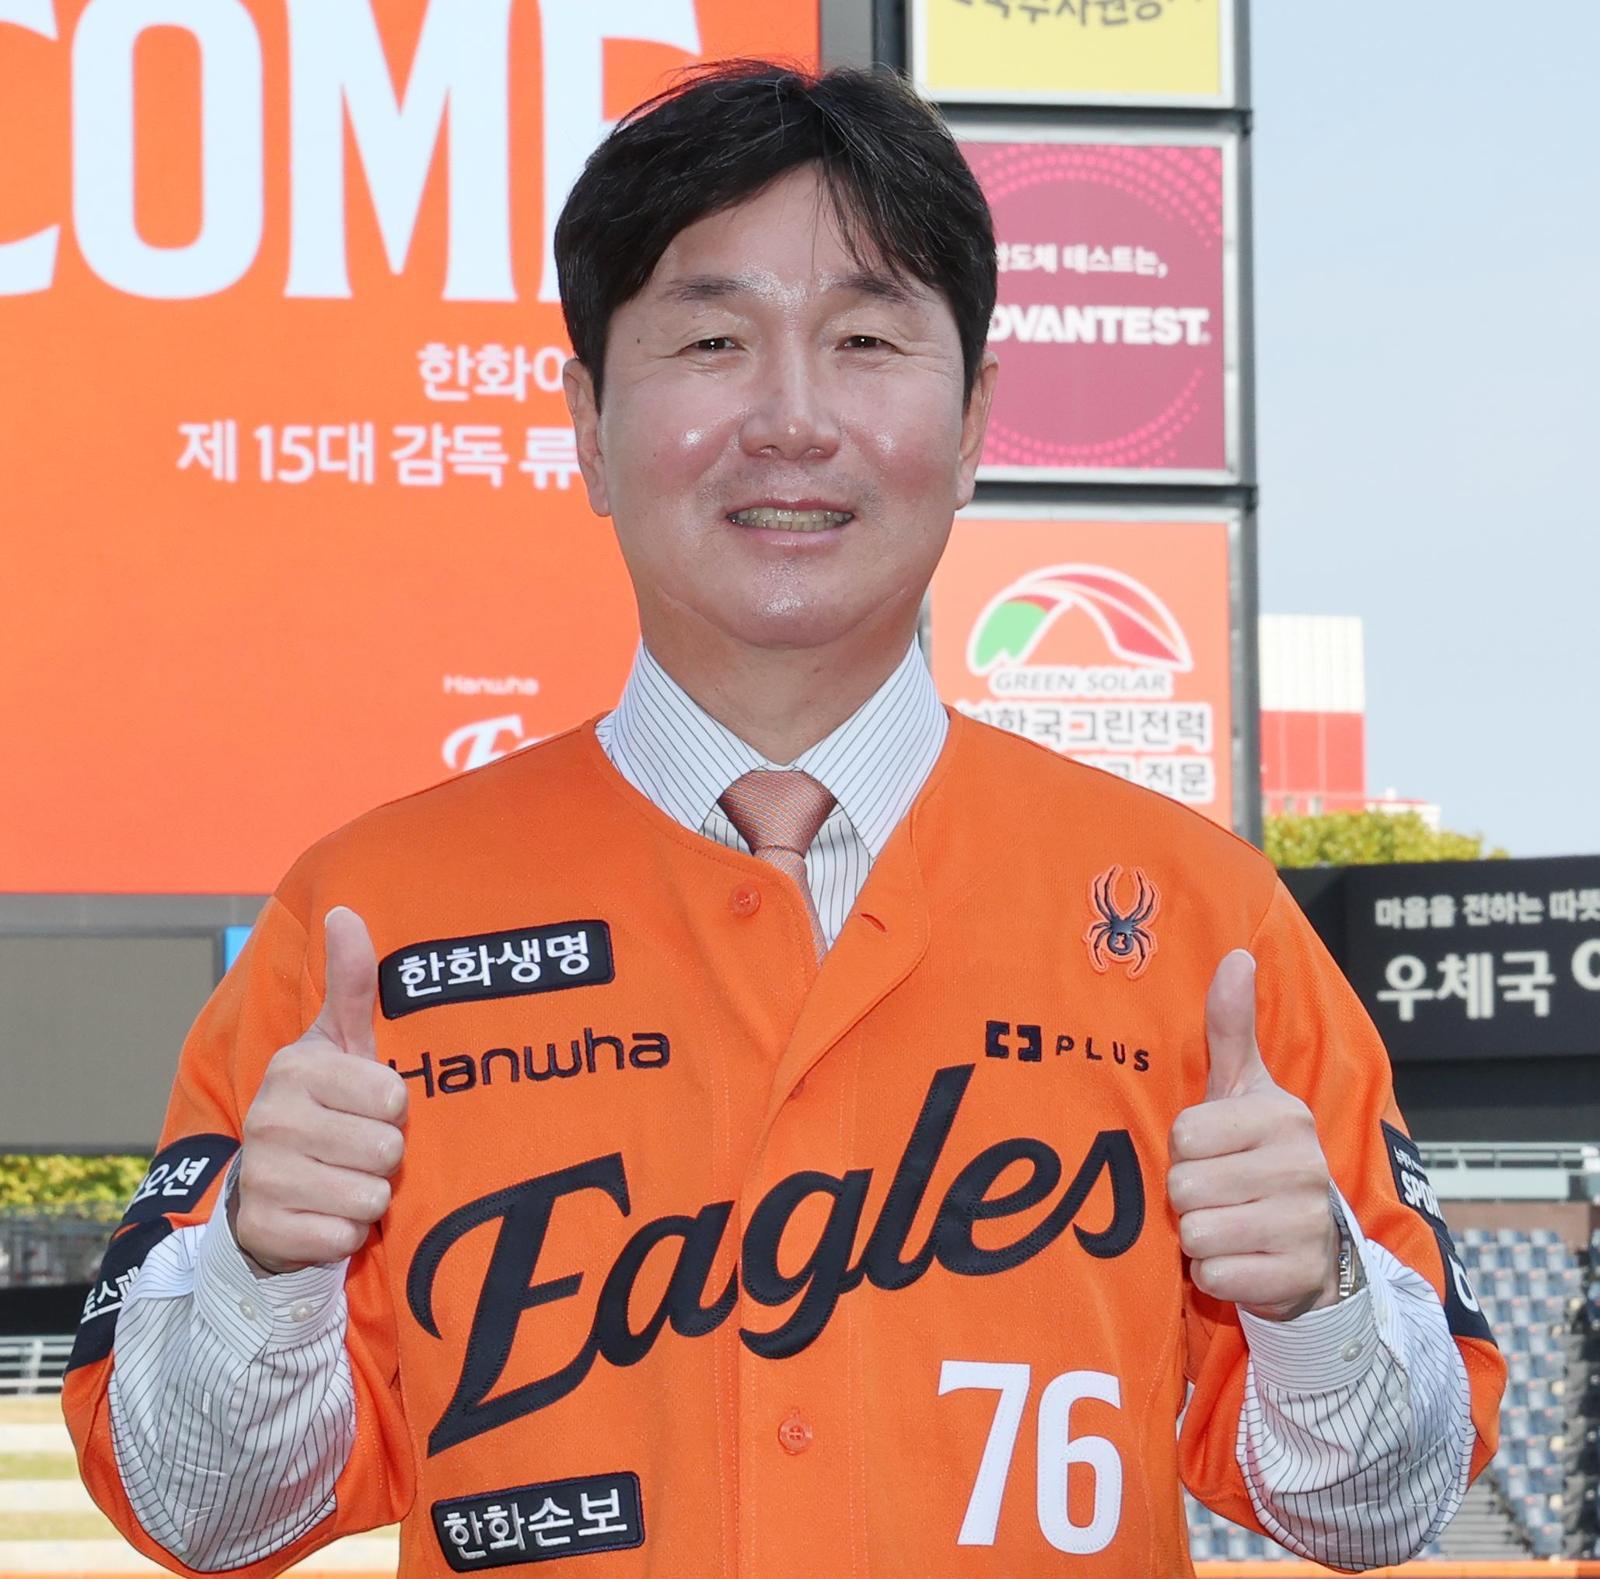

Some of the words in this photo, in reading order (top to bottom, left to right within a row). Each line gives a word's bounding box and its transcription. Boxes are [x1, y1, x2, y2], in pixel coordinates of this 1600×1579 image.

[1062, 244, 1168, 278] 테스트는,
[177, 419, 237, 483] 제
[253, 421, 375, 485] 15대
[390, 422, 509, 489] 감독
[442, 675, 540, 696] Hanwha
[995, 672, 1076, 690] GREEN
[1086, 671, 1167, 691] SOLAR
[1375, 894, 1456, 929] 마음을
[397, 931, 590, 998] 한화생명
[1376, 950, 1556, 1022] 우체국
[388, 1027, 671, 1099] Hanwha
[1056, 1035, 1150, 1073] PLUS
[132, 1157, 210, 1204] 오션
[405, 1063, 1147, 1458] Eagles
[937, 1360, 1123, 1555] 76
[443, 1488, 628, 1560] 한화손보
